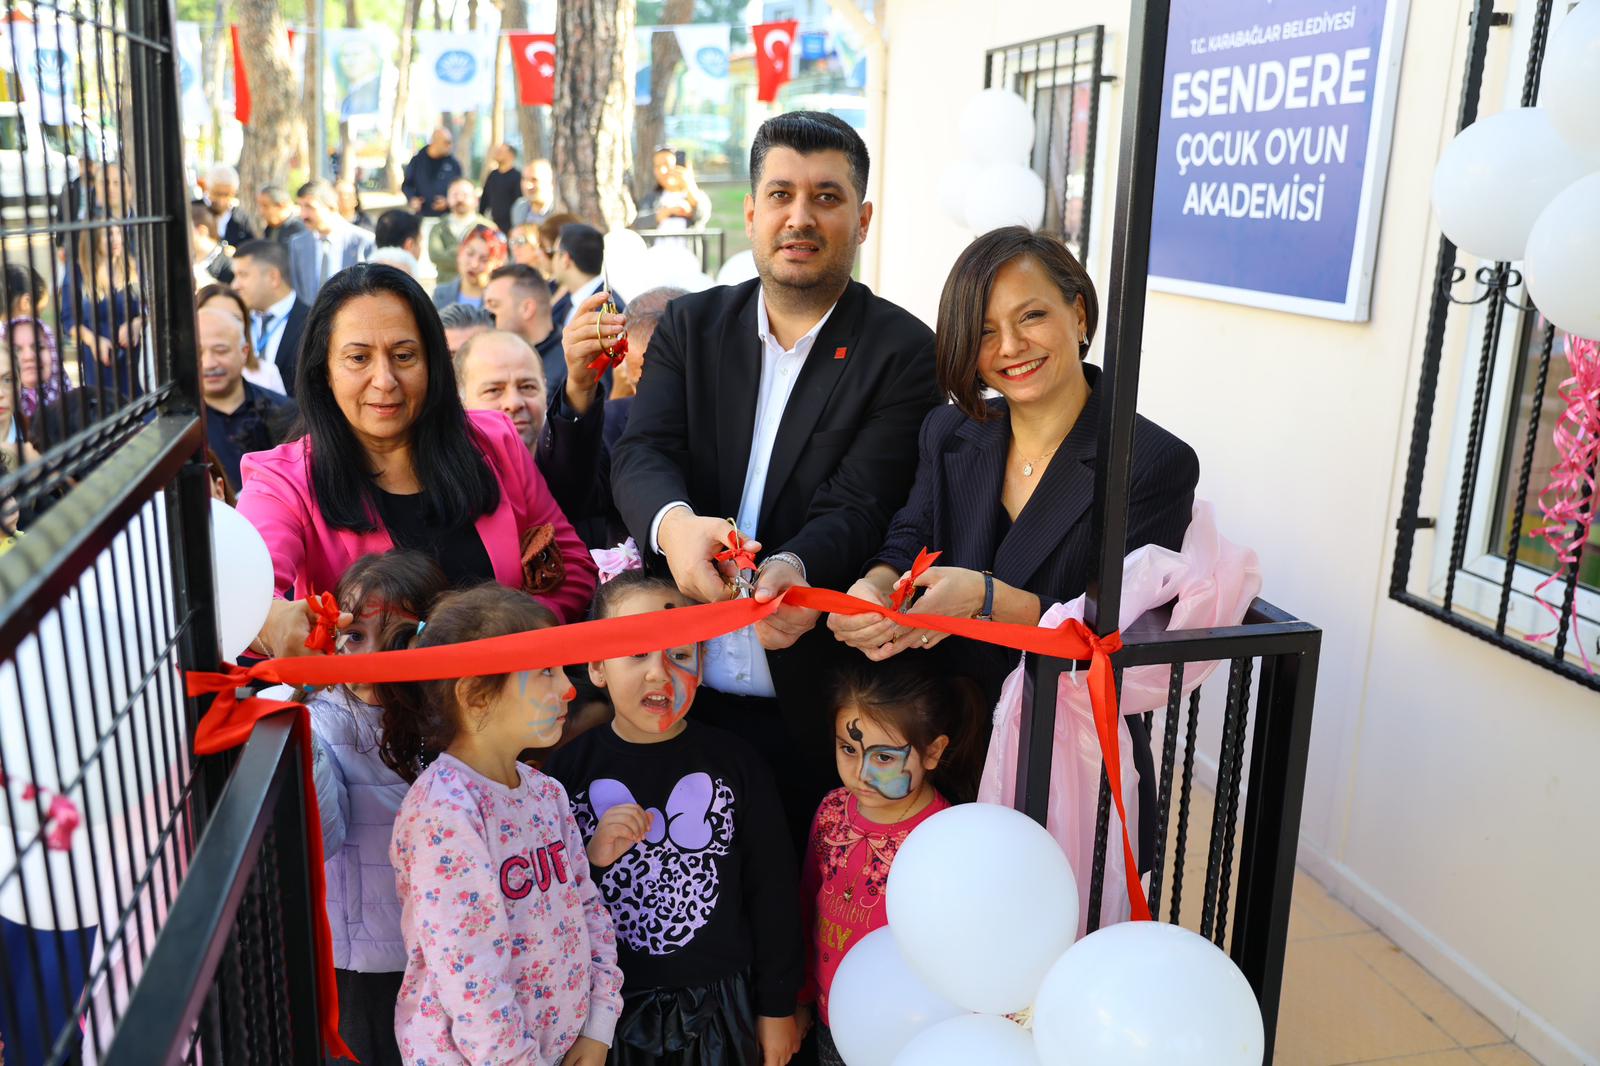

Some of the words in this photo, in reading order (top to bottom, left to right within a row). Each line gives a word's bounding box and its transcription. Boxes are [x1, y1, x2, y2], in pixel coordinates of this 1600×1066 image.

[1190, 37, 1208, 55] T.C.
[1207, 24, 1282, 52] KARABAĞLAR
[1282, 6, 1356, 40] BELEDİYESİ
[1171, 47, 1371, 119] ESENDERE
[1176, 129, 1260, 176] ÇOCUK
[1265, 125, 1349, 165] OYUN
[1182, 173, 1326, 222] AKADEMİSİ
